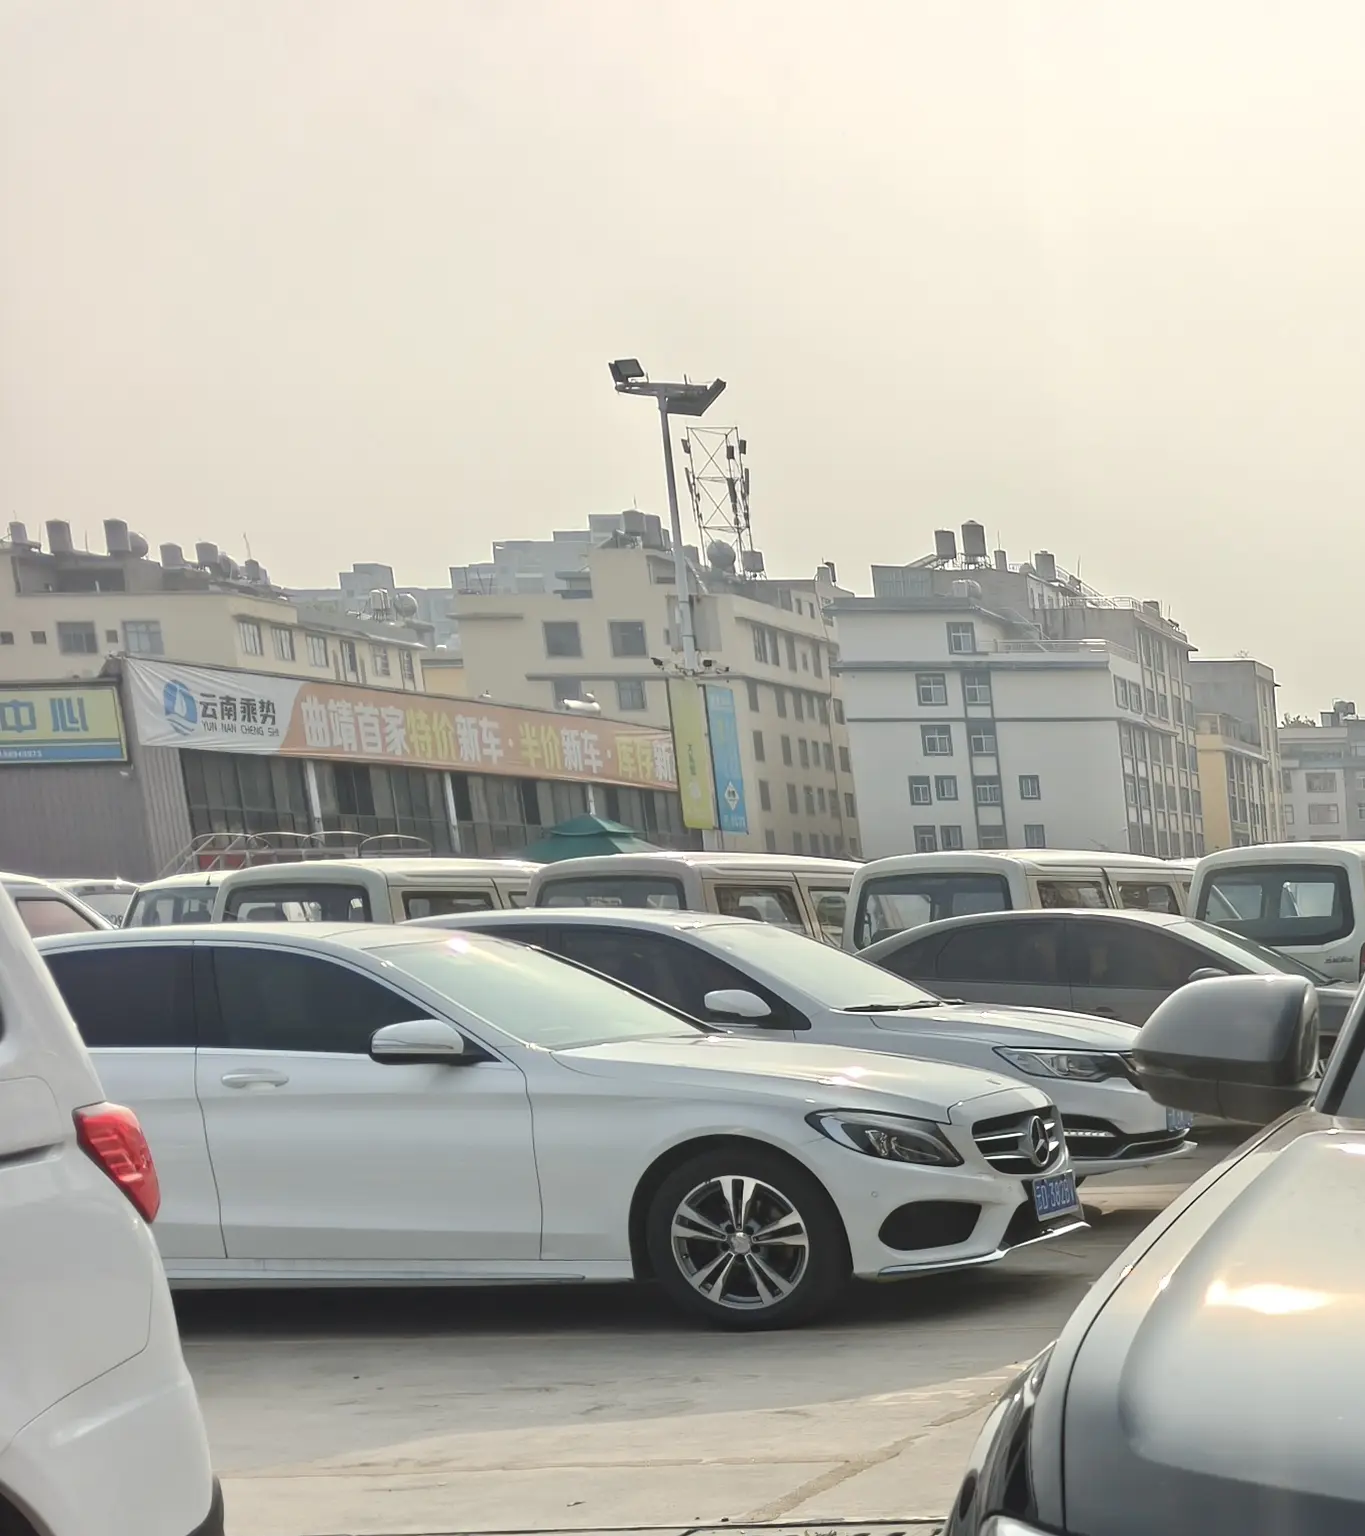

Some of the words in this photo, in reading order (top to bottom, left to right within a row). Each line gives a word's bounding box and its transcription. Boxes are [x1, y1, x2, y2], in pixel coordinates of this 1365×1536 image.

[199, 692, 277, 726] 云南乘势
[202, 720, 218, 732] YUN
[220, 722, 237, 734] NAN
[240, 725, 265, 737] CHENG
